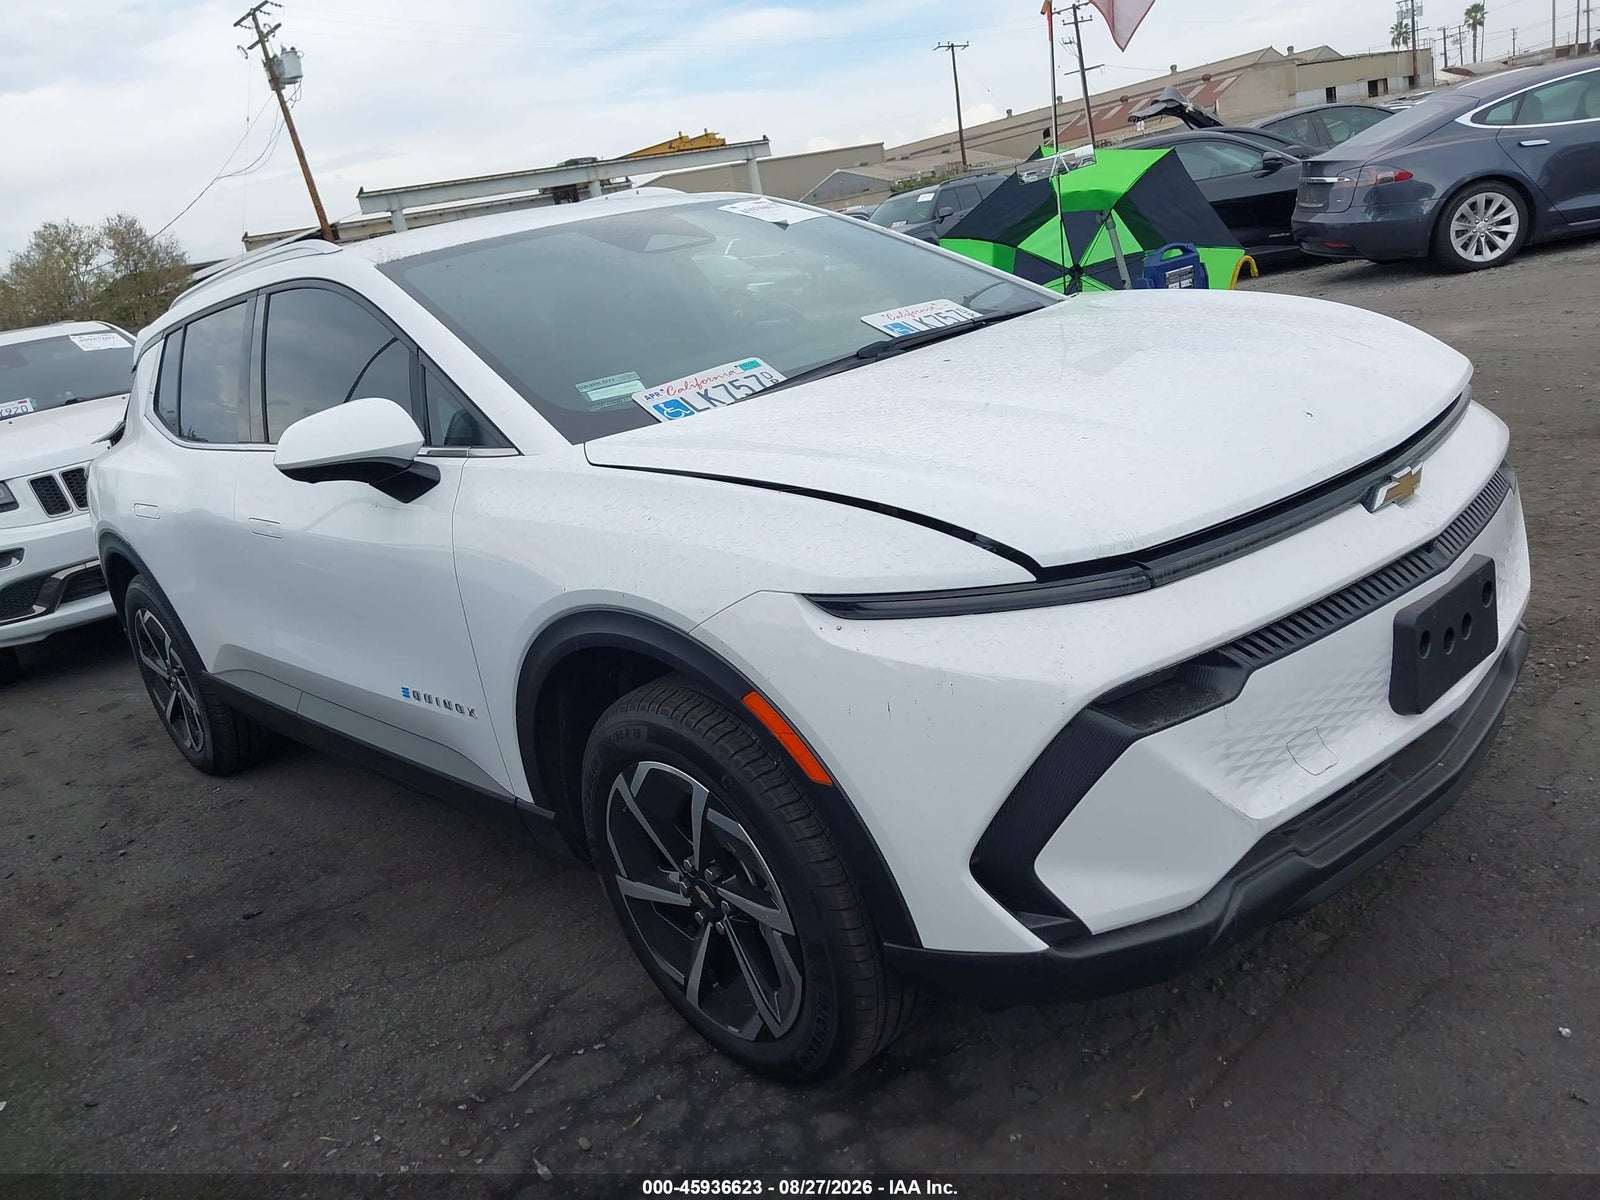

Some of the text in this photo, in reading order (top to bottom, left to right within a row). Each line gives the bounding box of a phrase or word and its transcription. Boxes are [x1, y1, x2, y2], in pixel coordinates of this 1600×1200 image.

[644, 393, 662, 401] APR
[666, 370, 738, 397] California
[401, 686, 478, 719] EQUINOX
